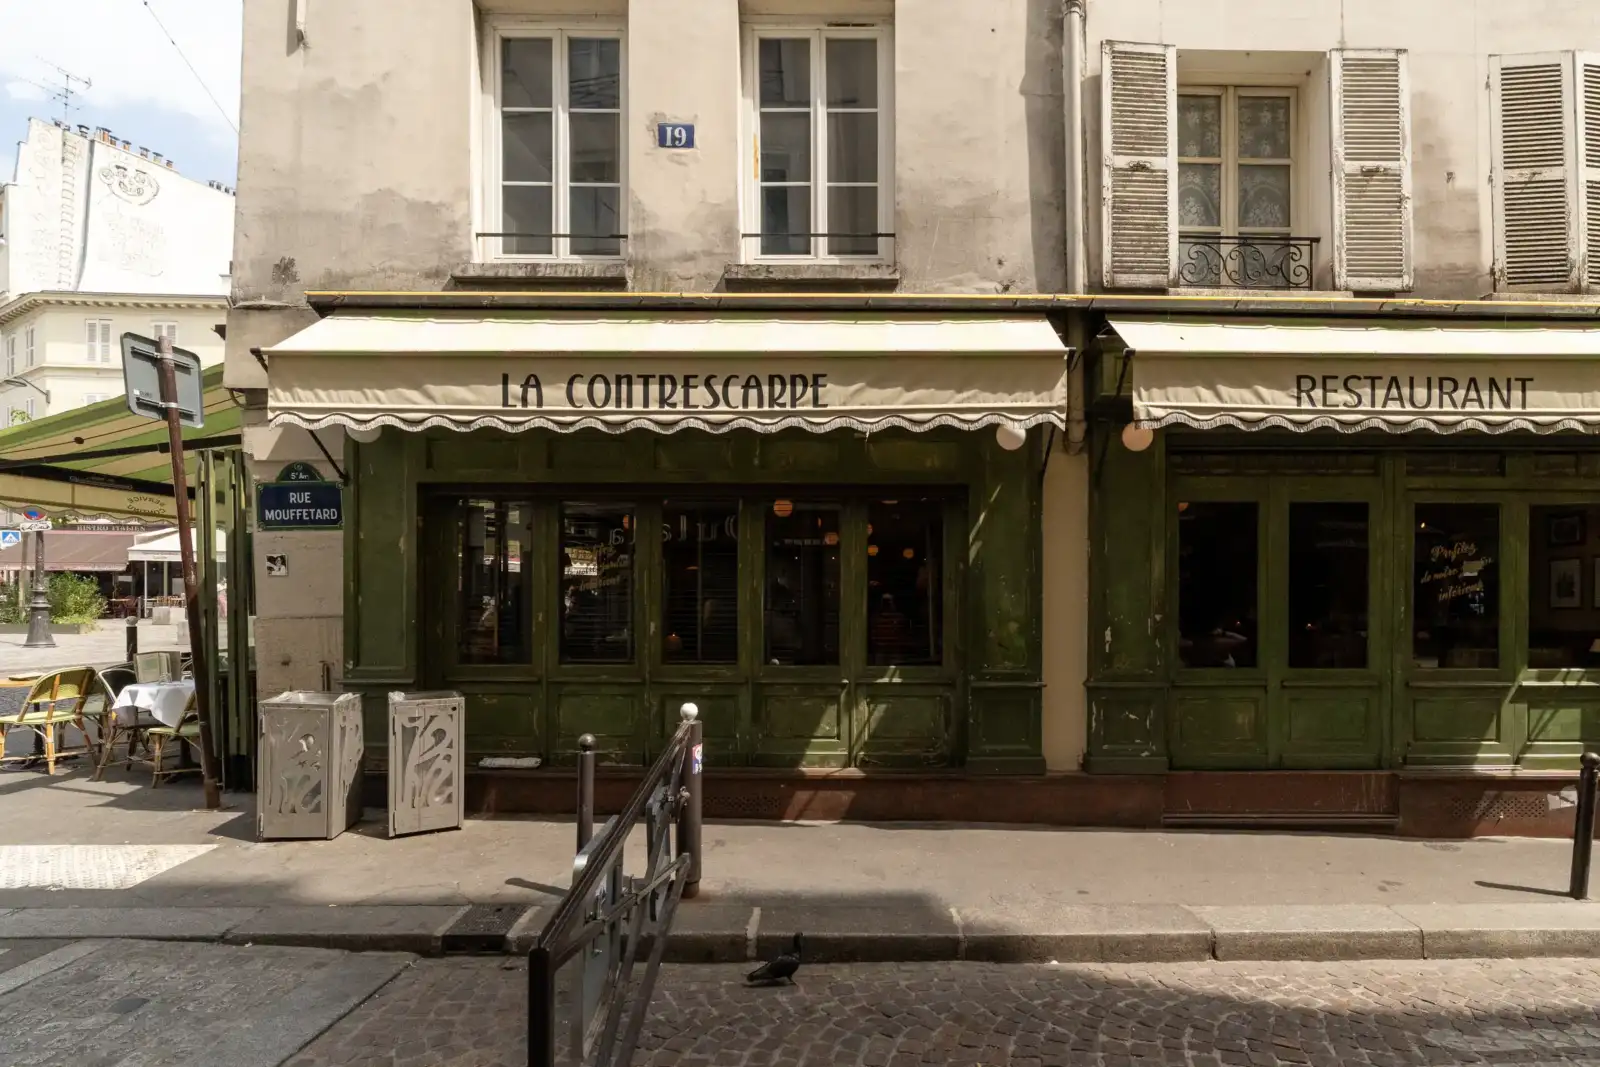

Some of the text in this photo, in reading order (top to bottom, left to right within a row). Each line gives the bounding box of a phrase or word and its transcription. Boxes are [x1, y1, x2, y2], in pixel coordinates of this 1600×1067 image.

[665, 126, 687, 147] 19
[501, 373, 829, 409] LA CONTRESCARPE
[1295, 374, 1534, 410] RESTAURANT
[289, 492, 311, 503] RUE
[265, 508, 338, 521] MOUFFETARD
